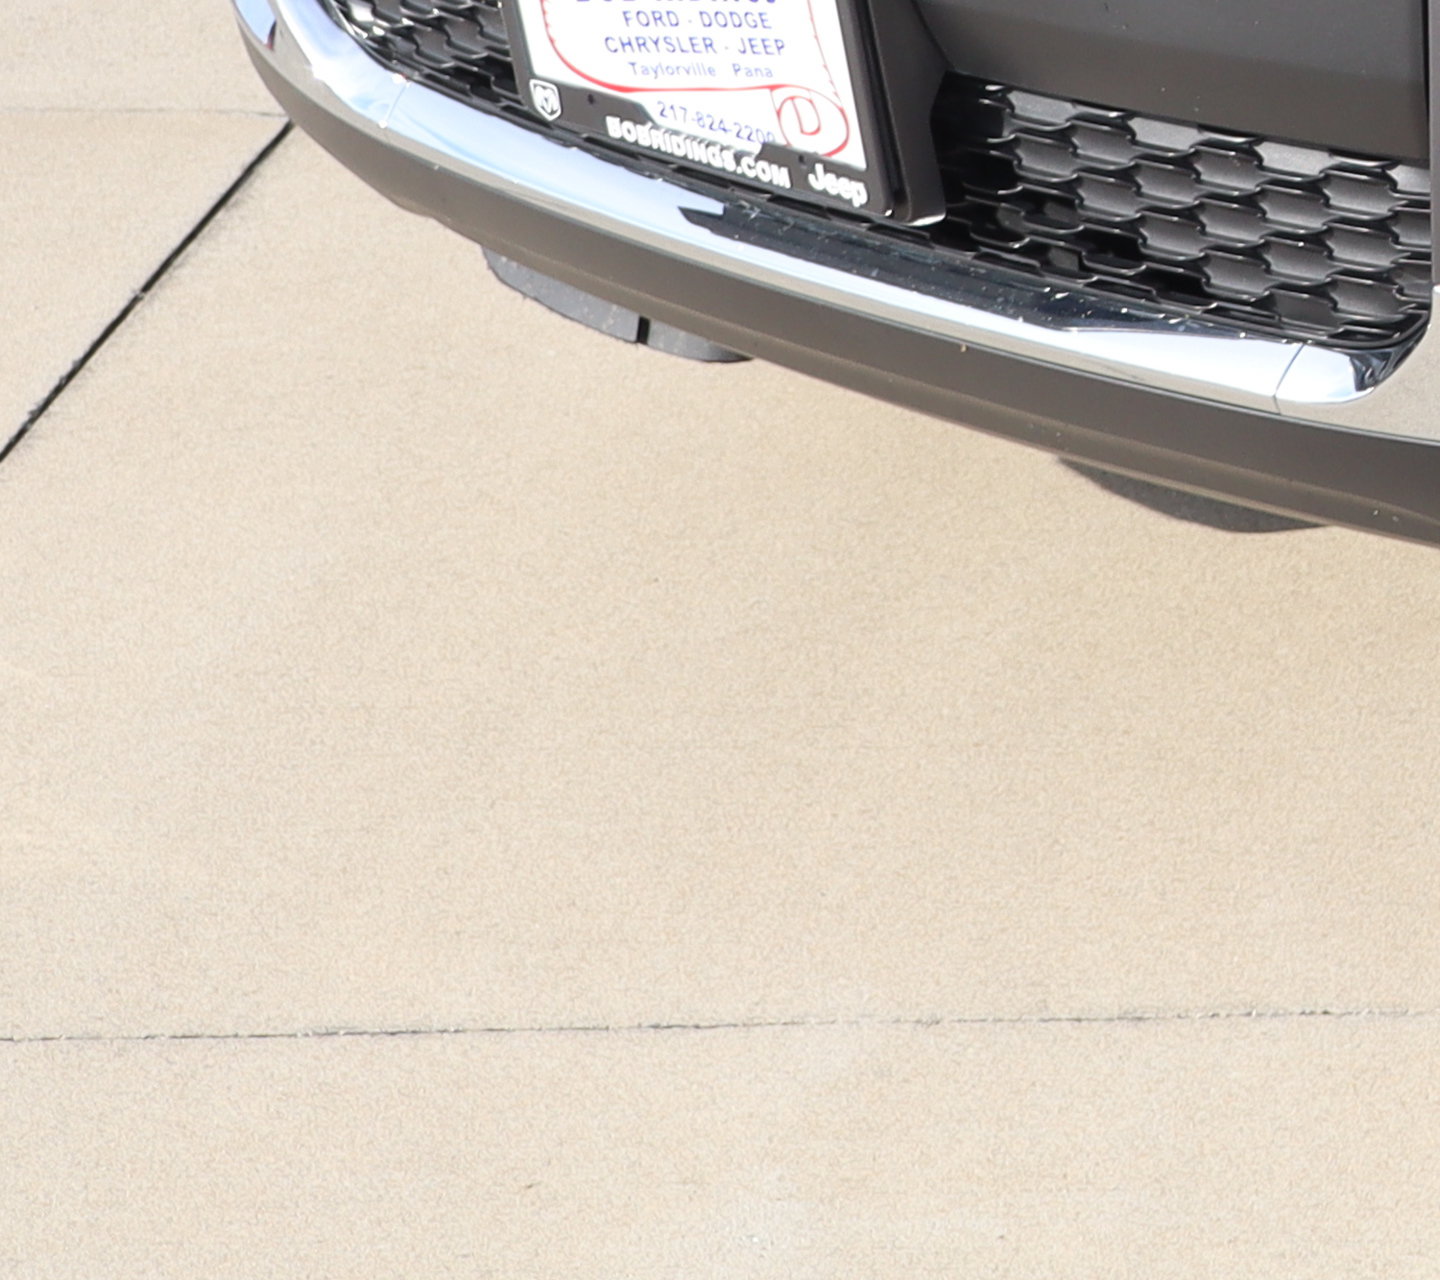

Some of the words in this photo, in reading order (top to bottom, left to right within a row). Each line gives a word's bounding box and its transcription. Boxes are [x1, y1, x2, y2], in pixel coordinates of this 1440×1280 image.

[622, 10, 679, 28] FORD
[699, 11, 772, 29] DODGE
[604, 36, 717, 54] CHRYSLER
[738, 37, 785, 56] JEEP
[628, 61, 717, 79] Taylorville
[732, 62, 774, 78] Pana
[605, 116, 791, 189] BOBRIDINGS.COM
[807, 163, 869, 207] Jeep
